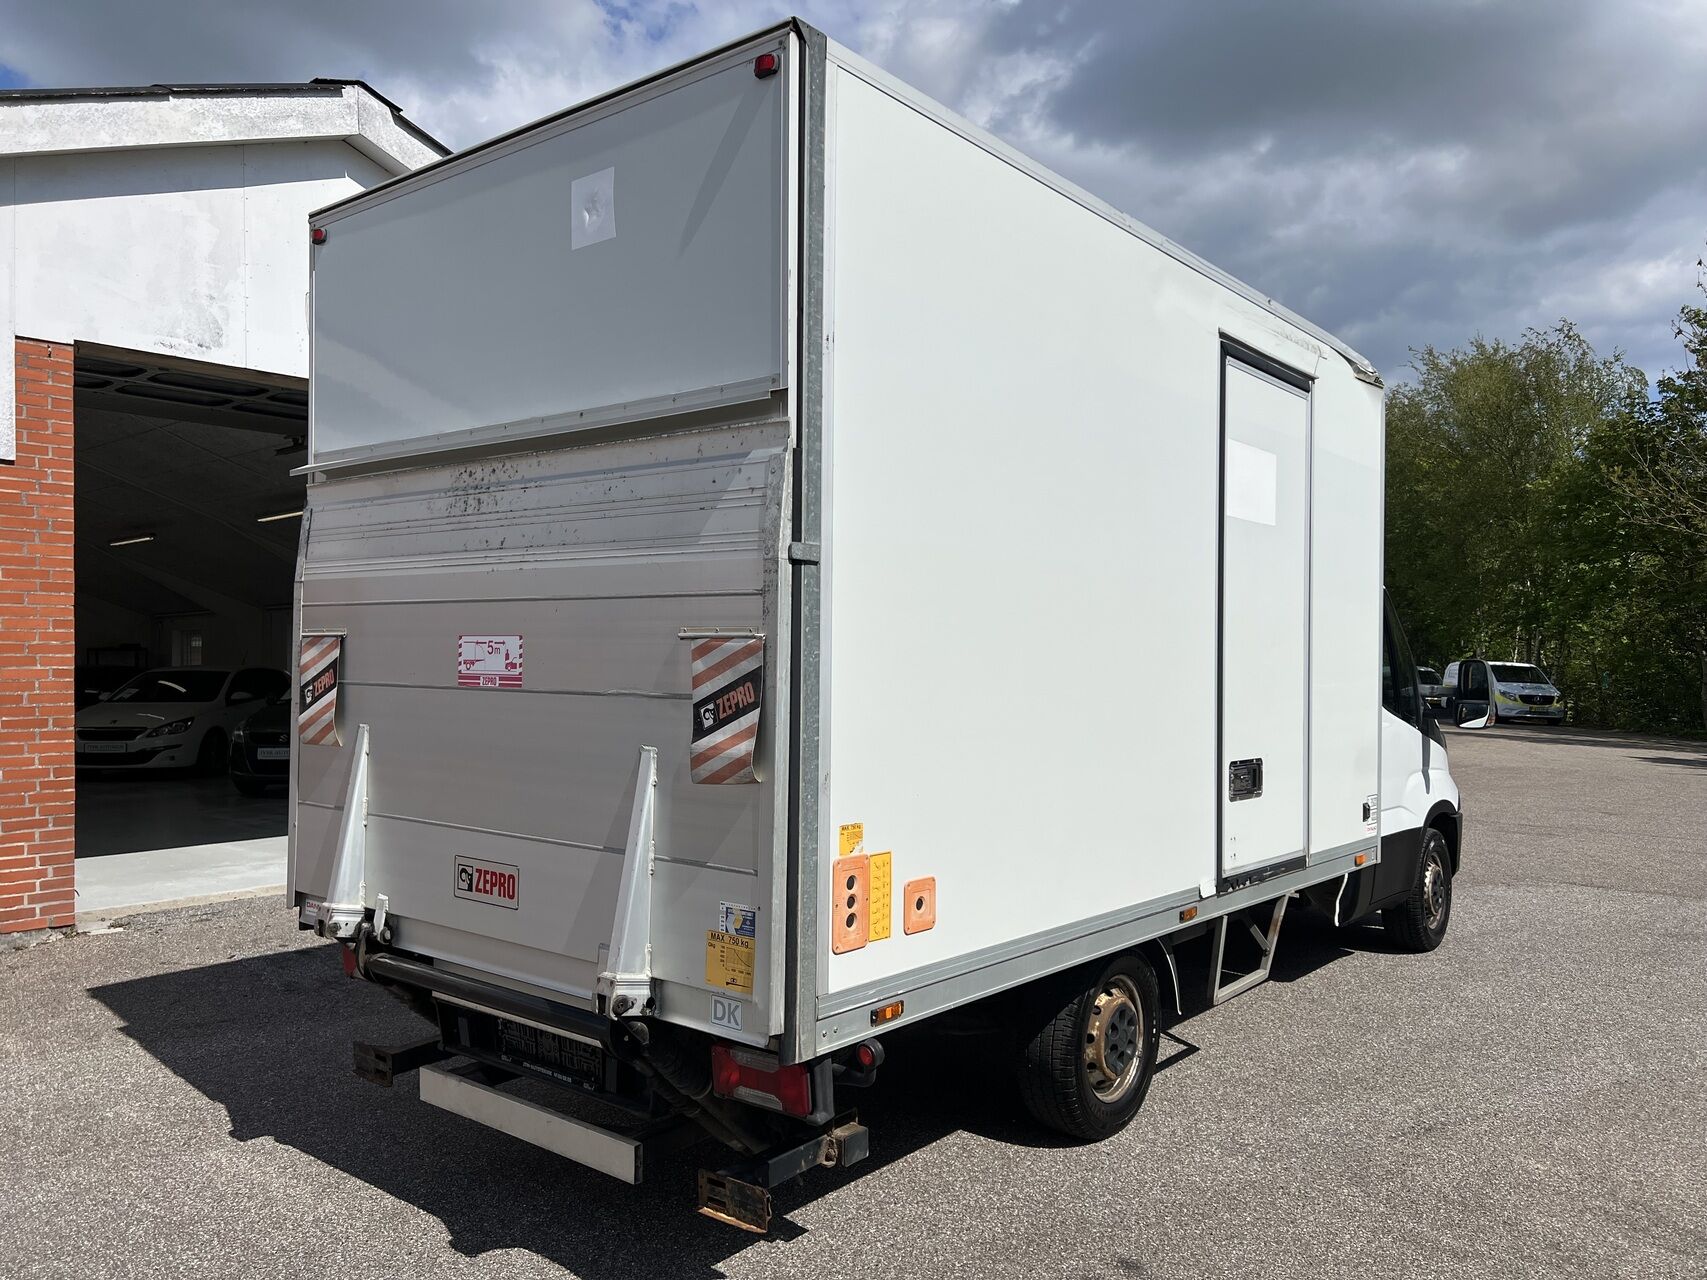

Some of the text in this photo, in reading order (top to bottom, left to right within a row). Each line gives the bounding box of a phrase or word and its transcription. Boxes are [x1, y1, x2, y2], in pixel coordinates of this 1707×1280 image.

[313, 668, 335, 698] ZEPRO
[716, 681, 755, 720] ZEPRO
[474, 868, 516, 900] ZEPRO
[710, 932, 749, 949] MAX 750 kg
[713, 999, 740, 1027] DK
